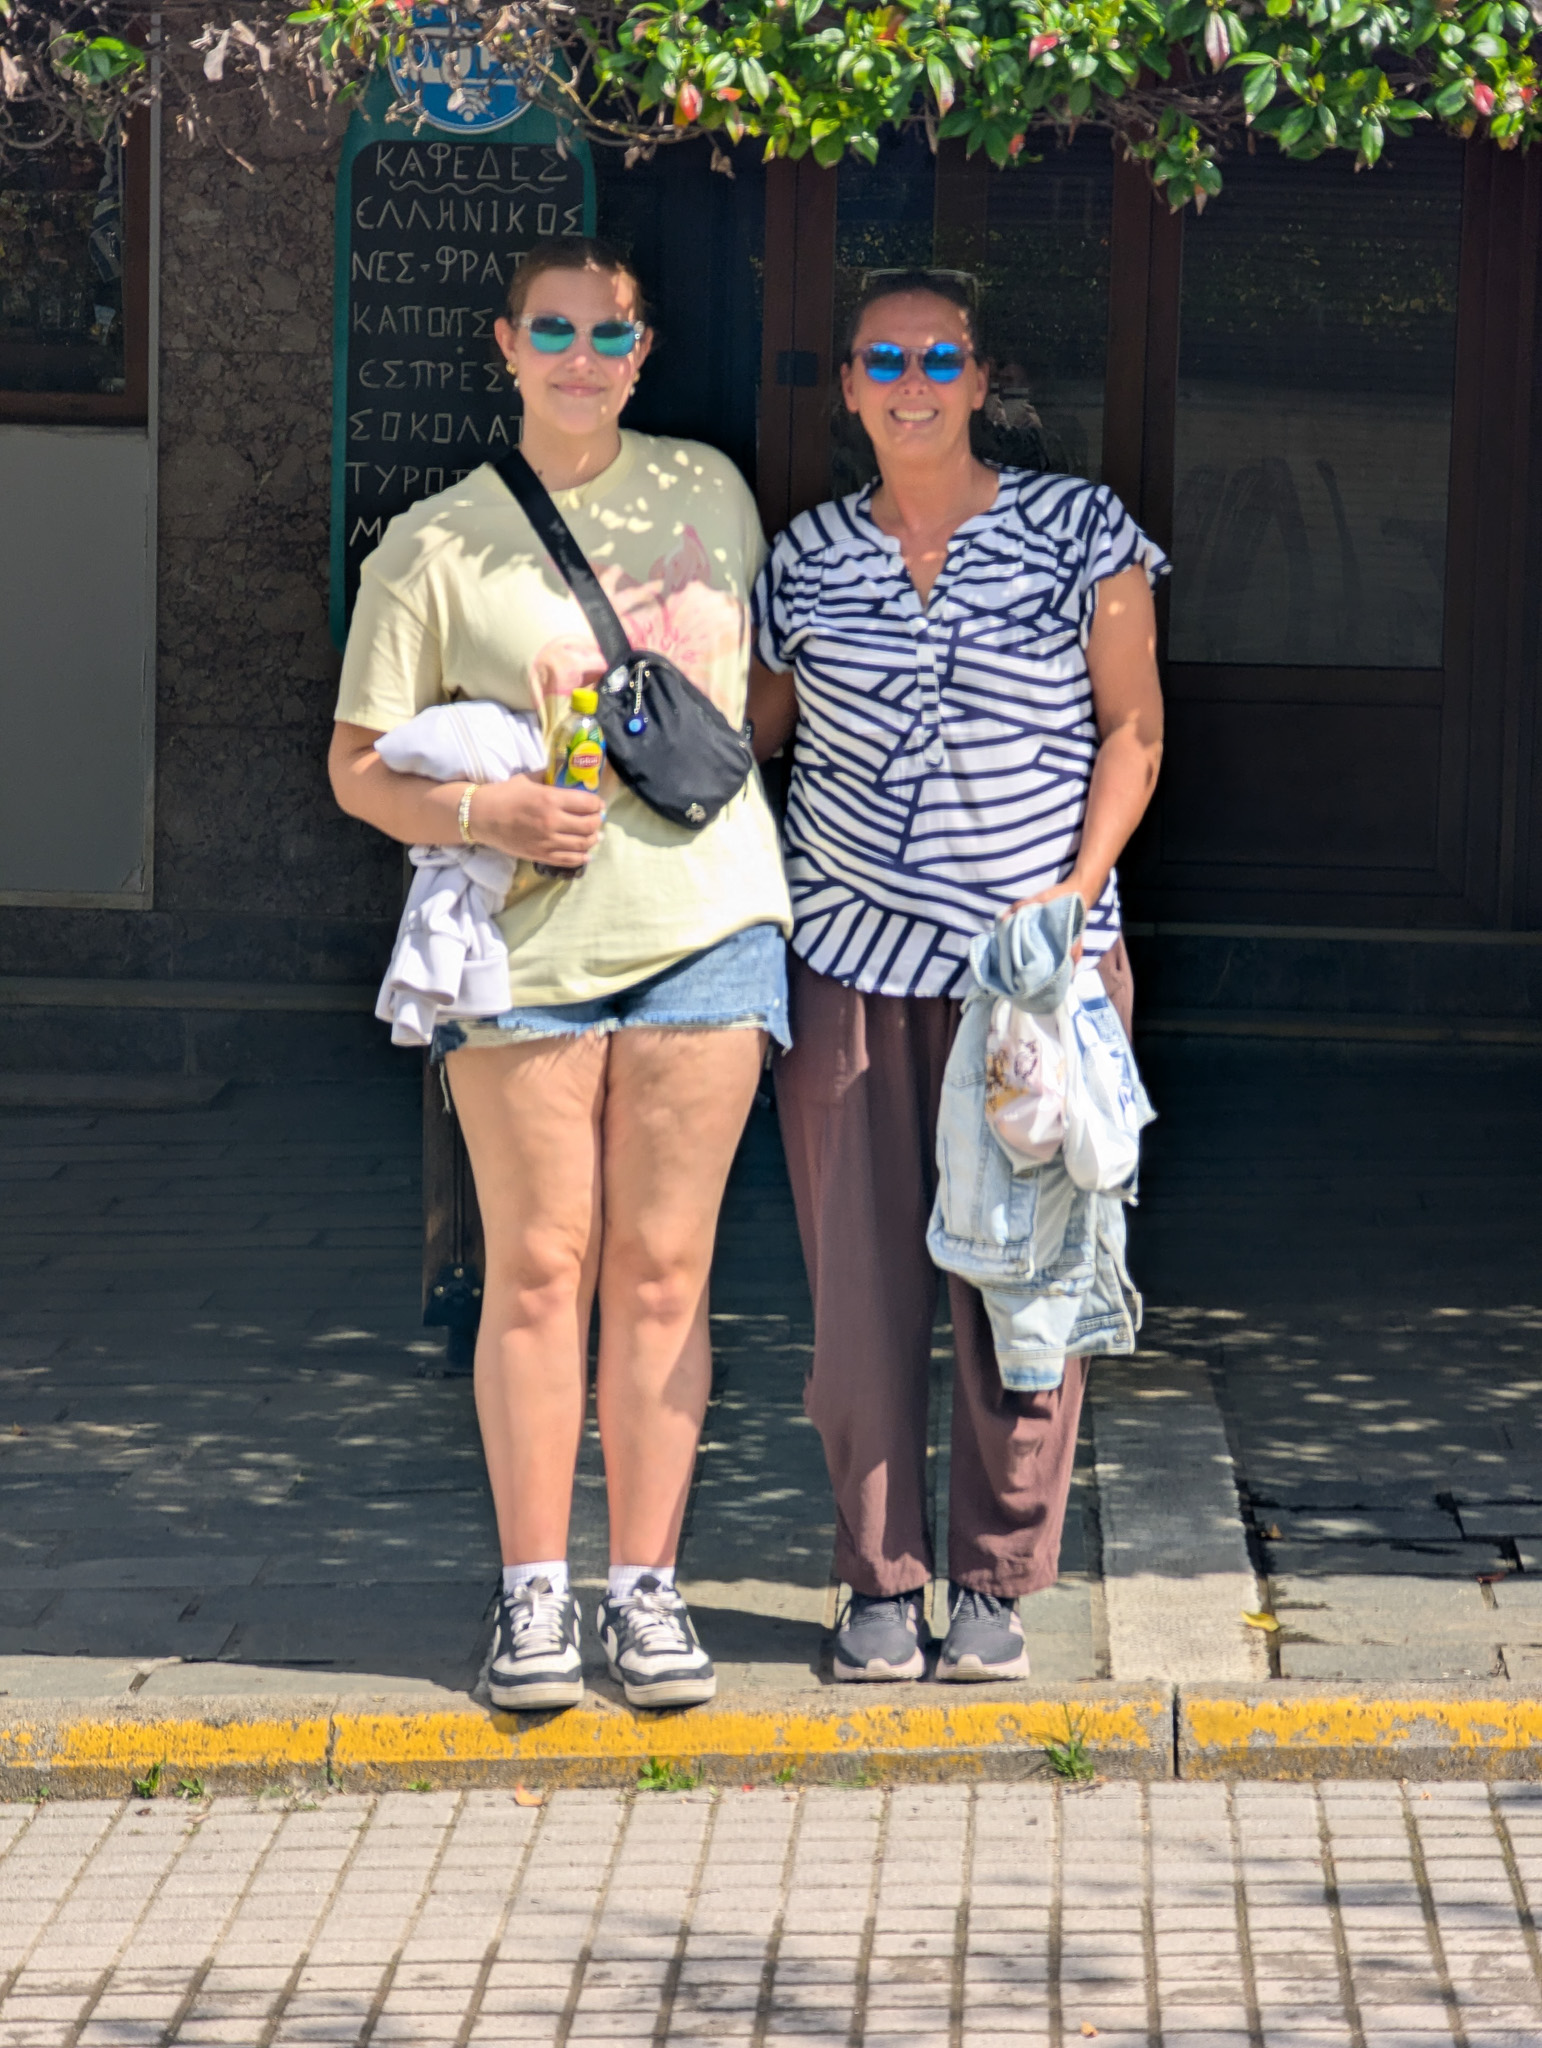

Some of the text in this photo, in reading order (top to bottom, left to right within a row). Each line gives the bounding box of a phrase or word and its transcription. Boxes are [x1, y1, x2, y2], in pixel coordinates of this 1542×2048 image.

[376, 142, 568, 182] ΚΑΦΕΔΕΣ
[356, 196, 584, 237] ΕΛΛΗΝΙΚΟΣ
[359, 359, 504, 392] ΕΣΠΡΕΣ
